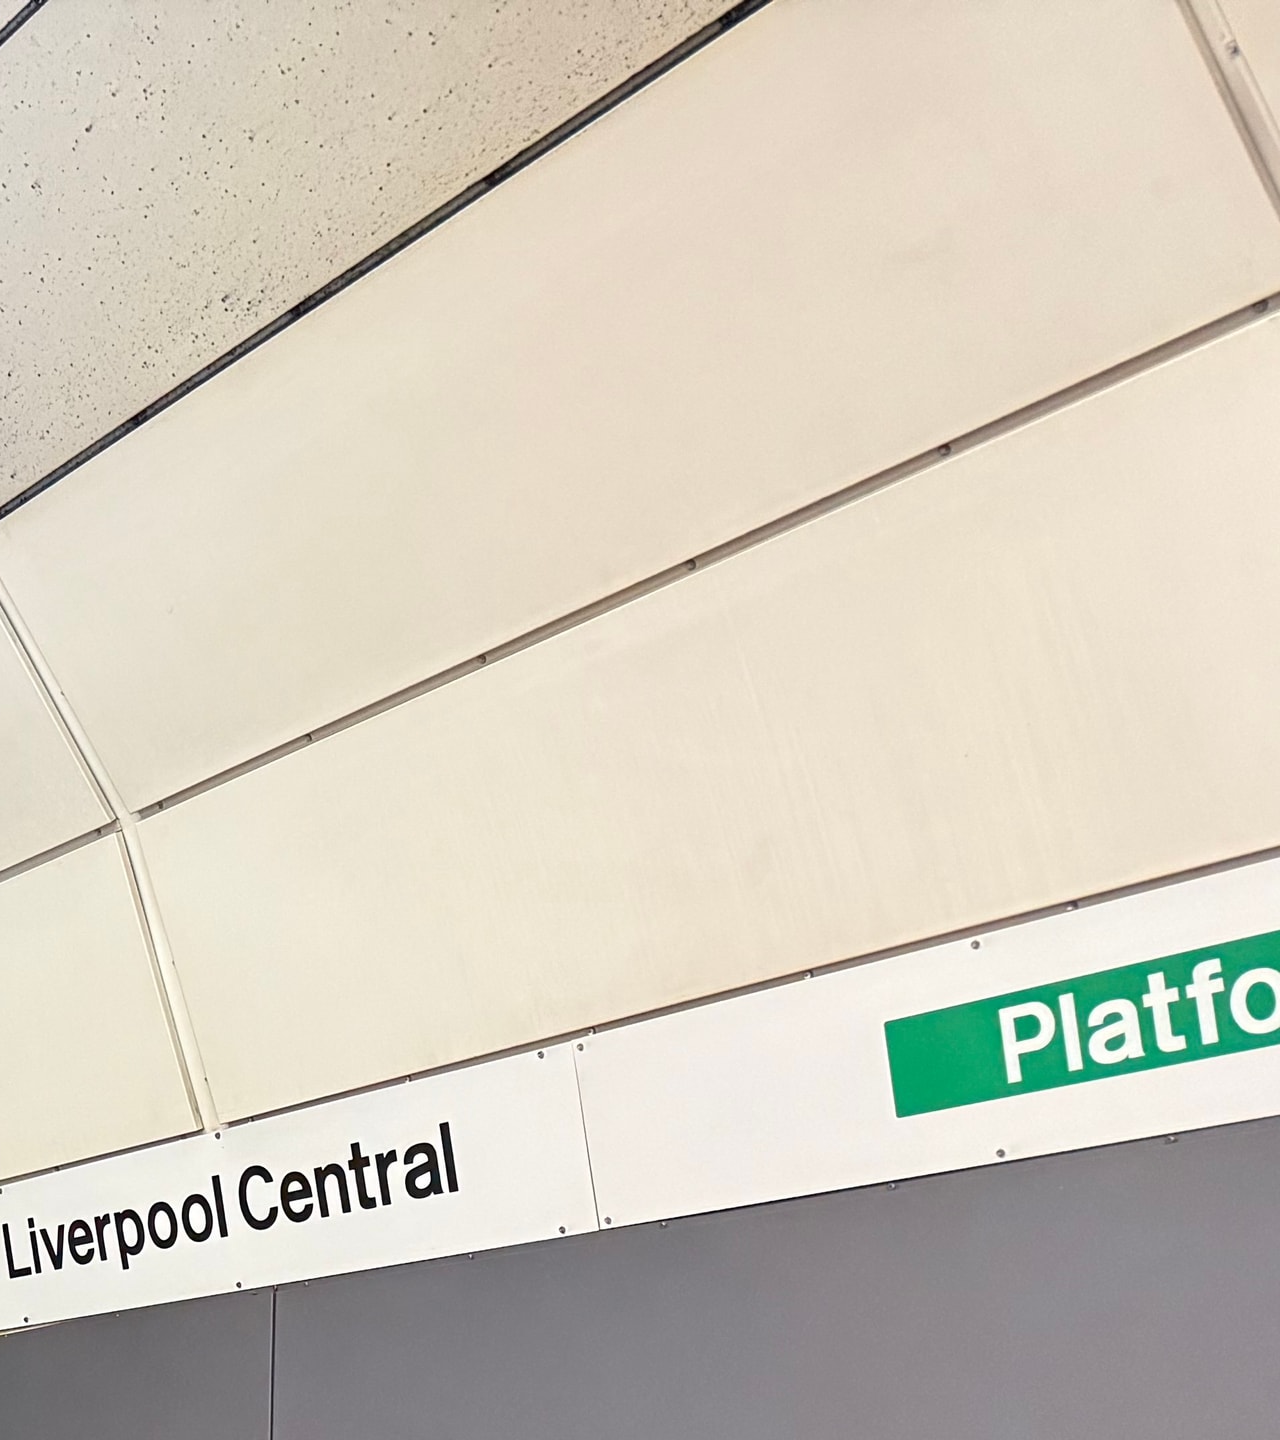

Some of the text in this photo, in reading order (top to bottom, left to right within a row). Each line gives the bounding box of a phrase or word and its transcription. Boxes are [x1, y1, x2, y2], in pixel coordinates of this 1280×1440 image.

[997, 957, 1280, 1085] Platfo
[1, 1121, 459, 1279] Liverpool Central
